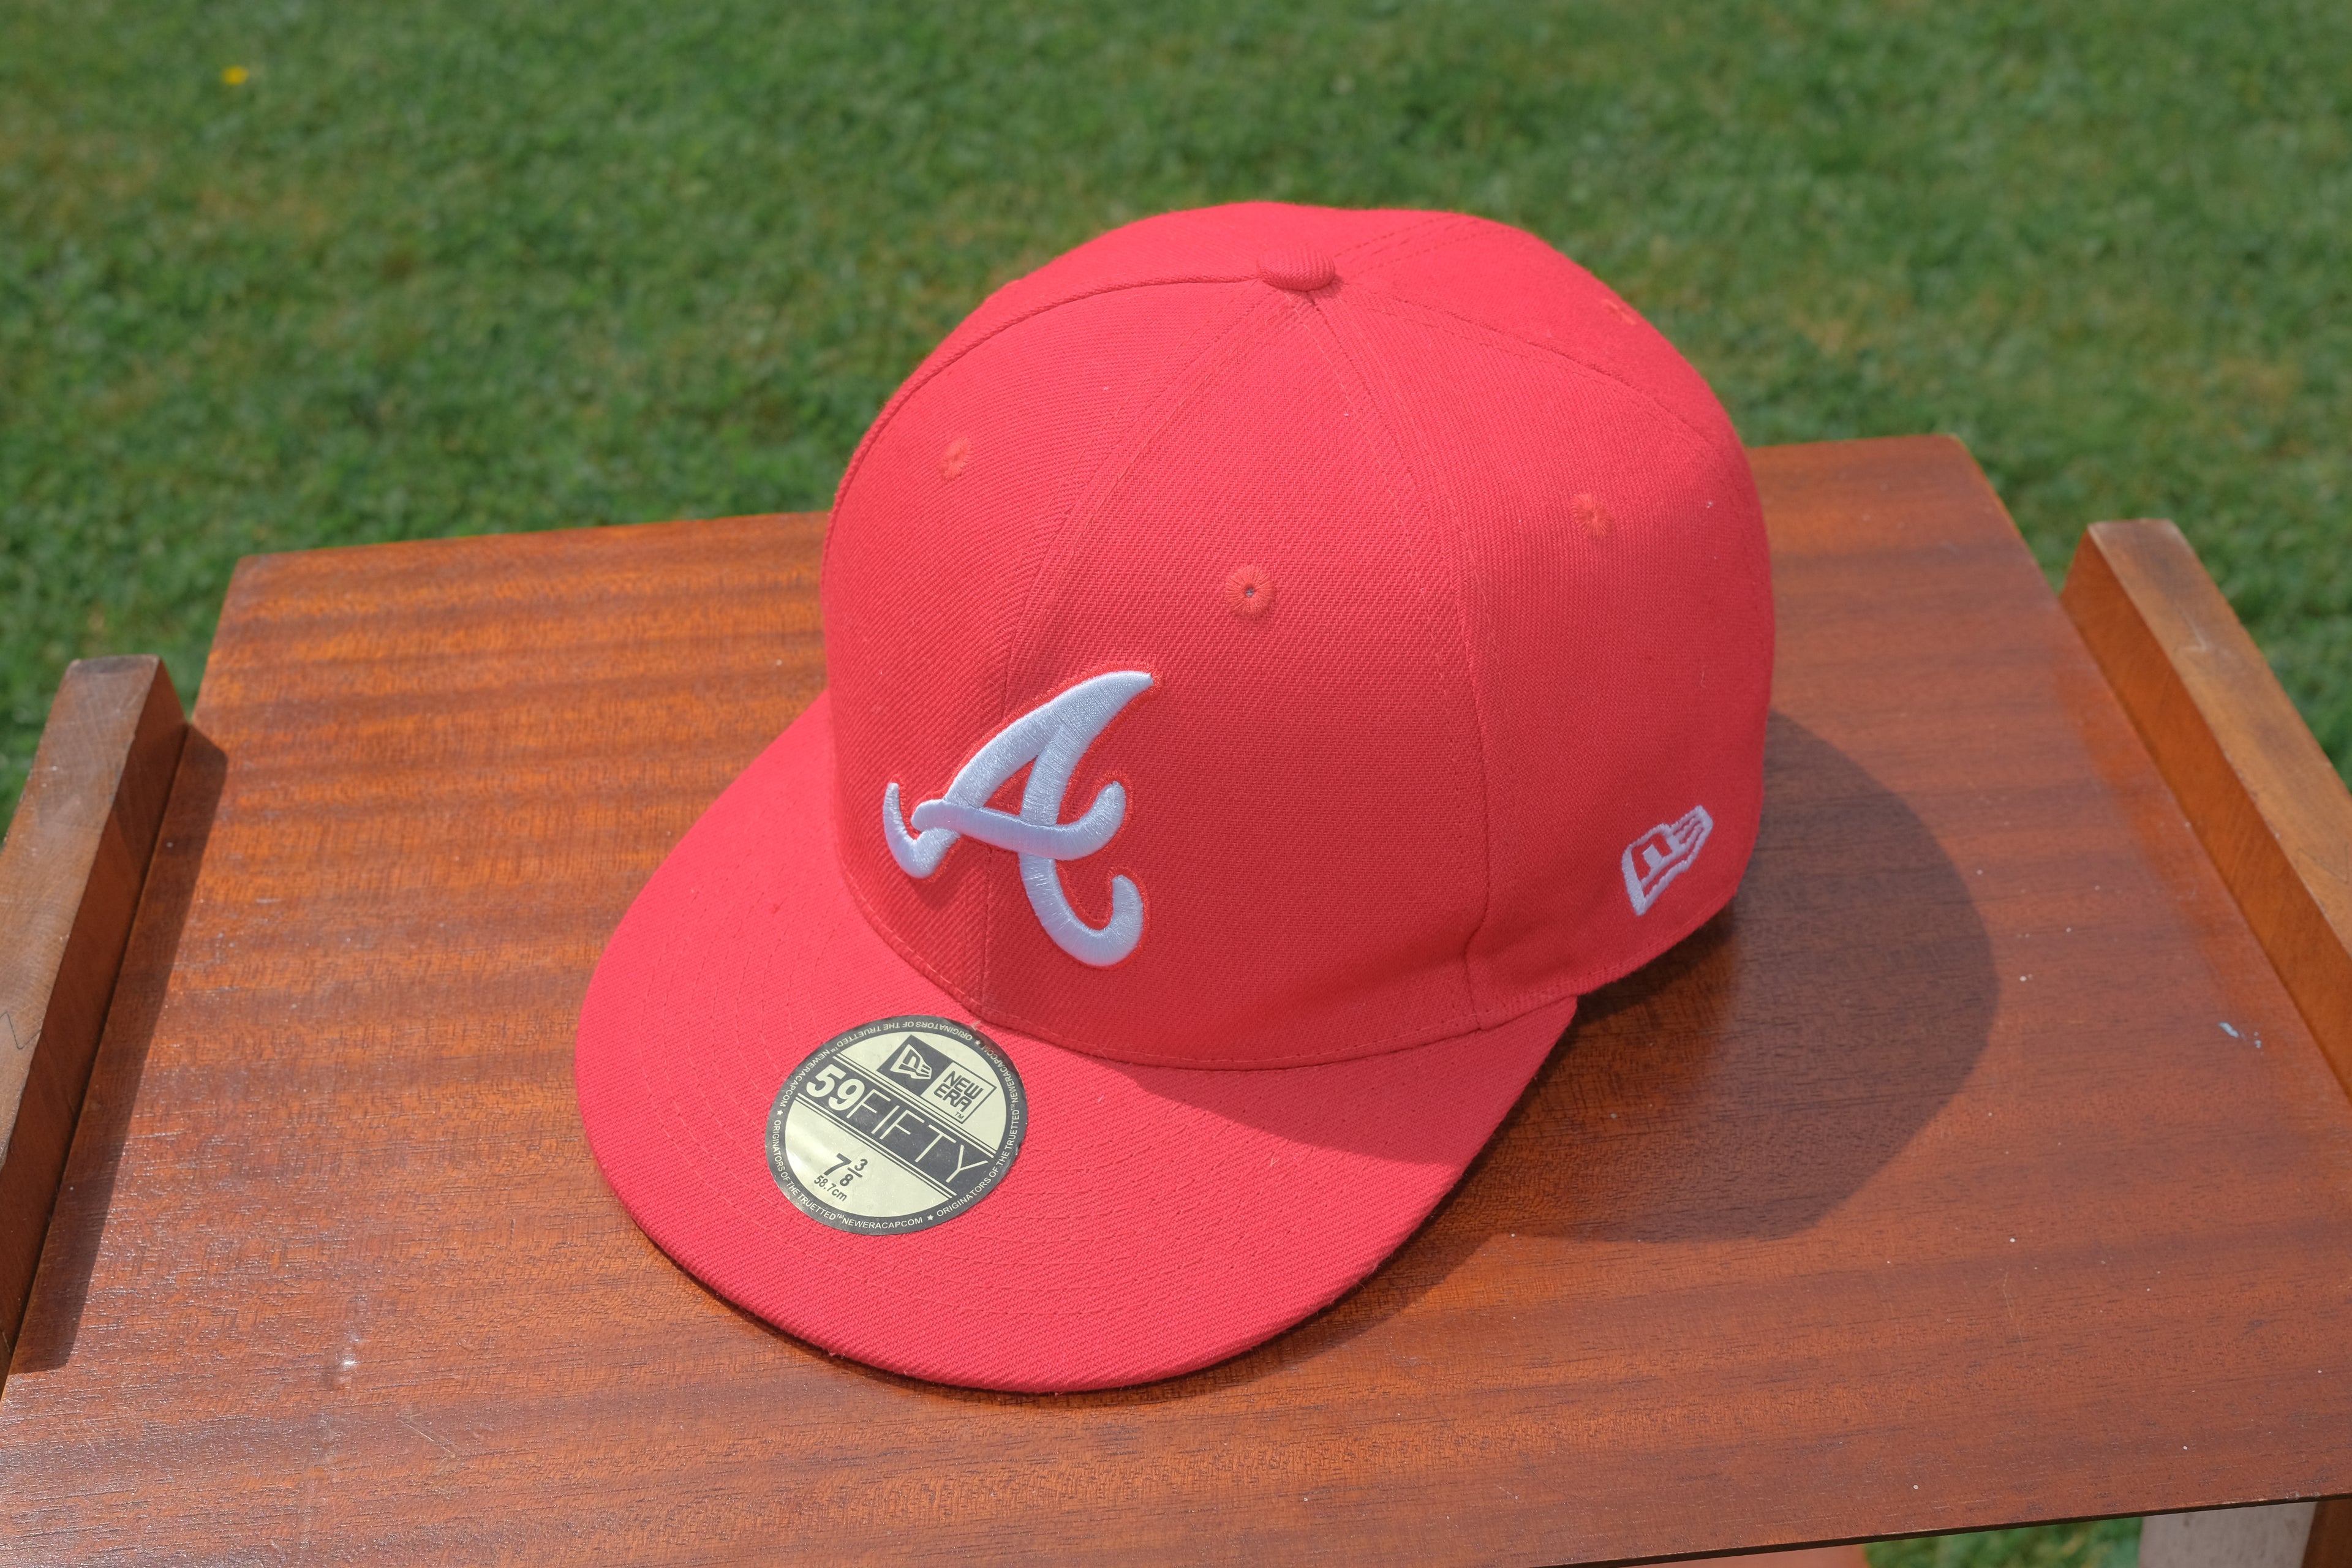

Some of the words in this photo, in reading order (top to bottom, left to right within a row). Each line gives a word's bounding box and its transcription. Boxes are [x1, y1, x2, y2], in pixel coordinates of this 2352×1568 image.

[916, 1021, 973, 1041] ORIGINATORS
[933, 1083, 973, 1112] ERA
[943, 1070, 984, 1100] NEW
[772, 1120, 785, 1172] ORIGINATORS
[780, 1172, 791, 1182] OF
[786, 1181, 801, 1196] THE
[813, 1175, 848, 1202] 58.7cm
[937, 1177, 992, 1217] ORIGINATORS
[989, 1166, 1002, 1178] OF
[997, 1151, 1010, 1166] THE
